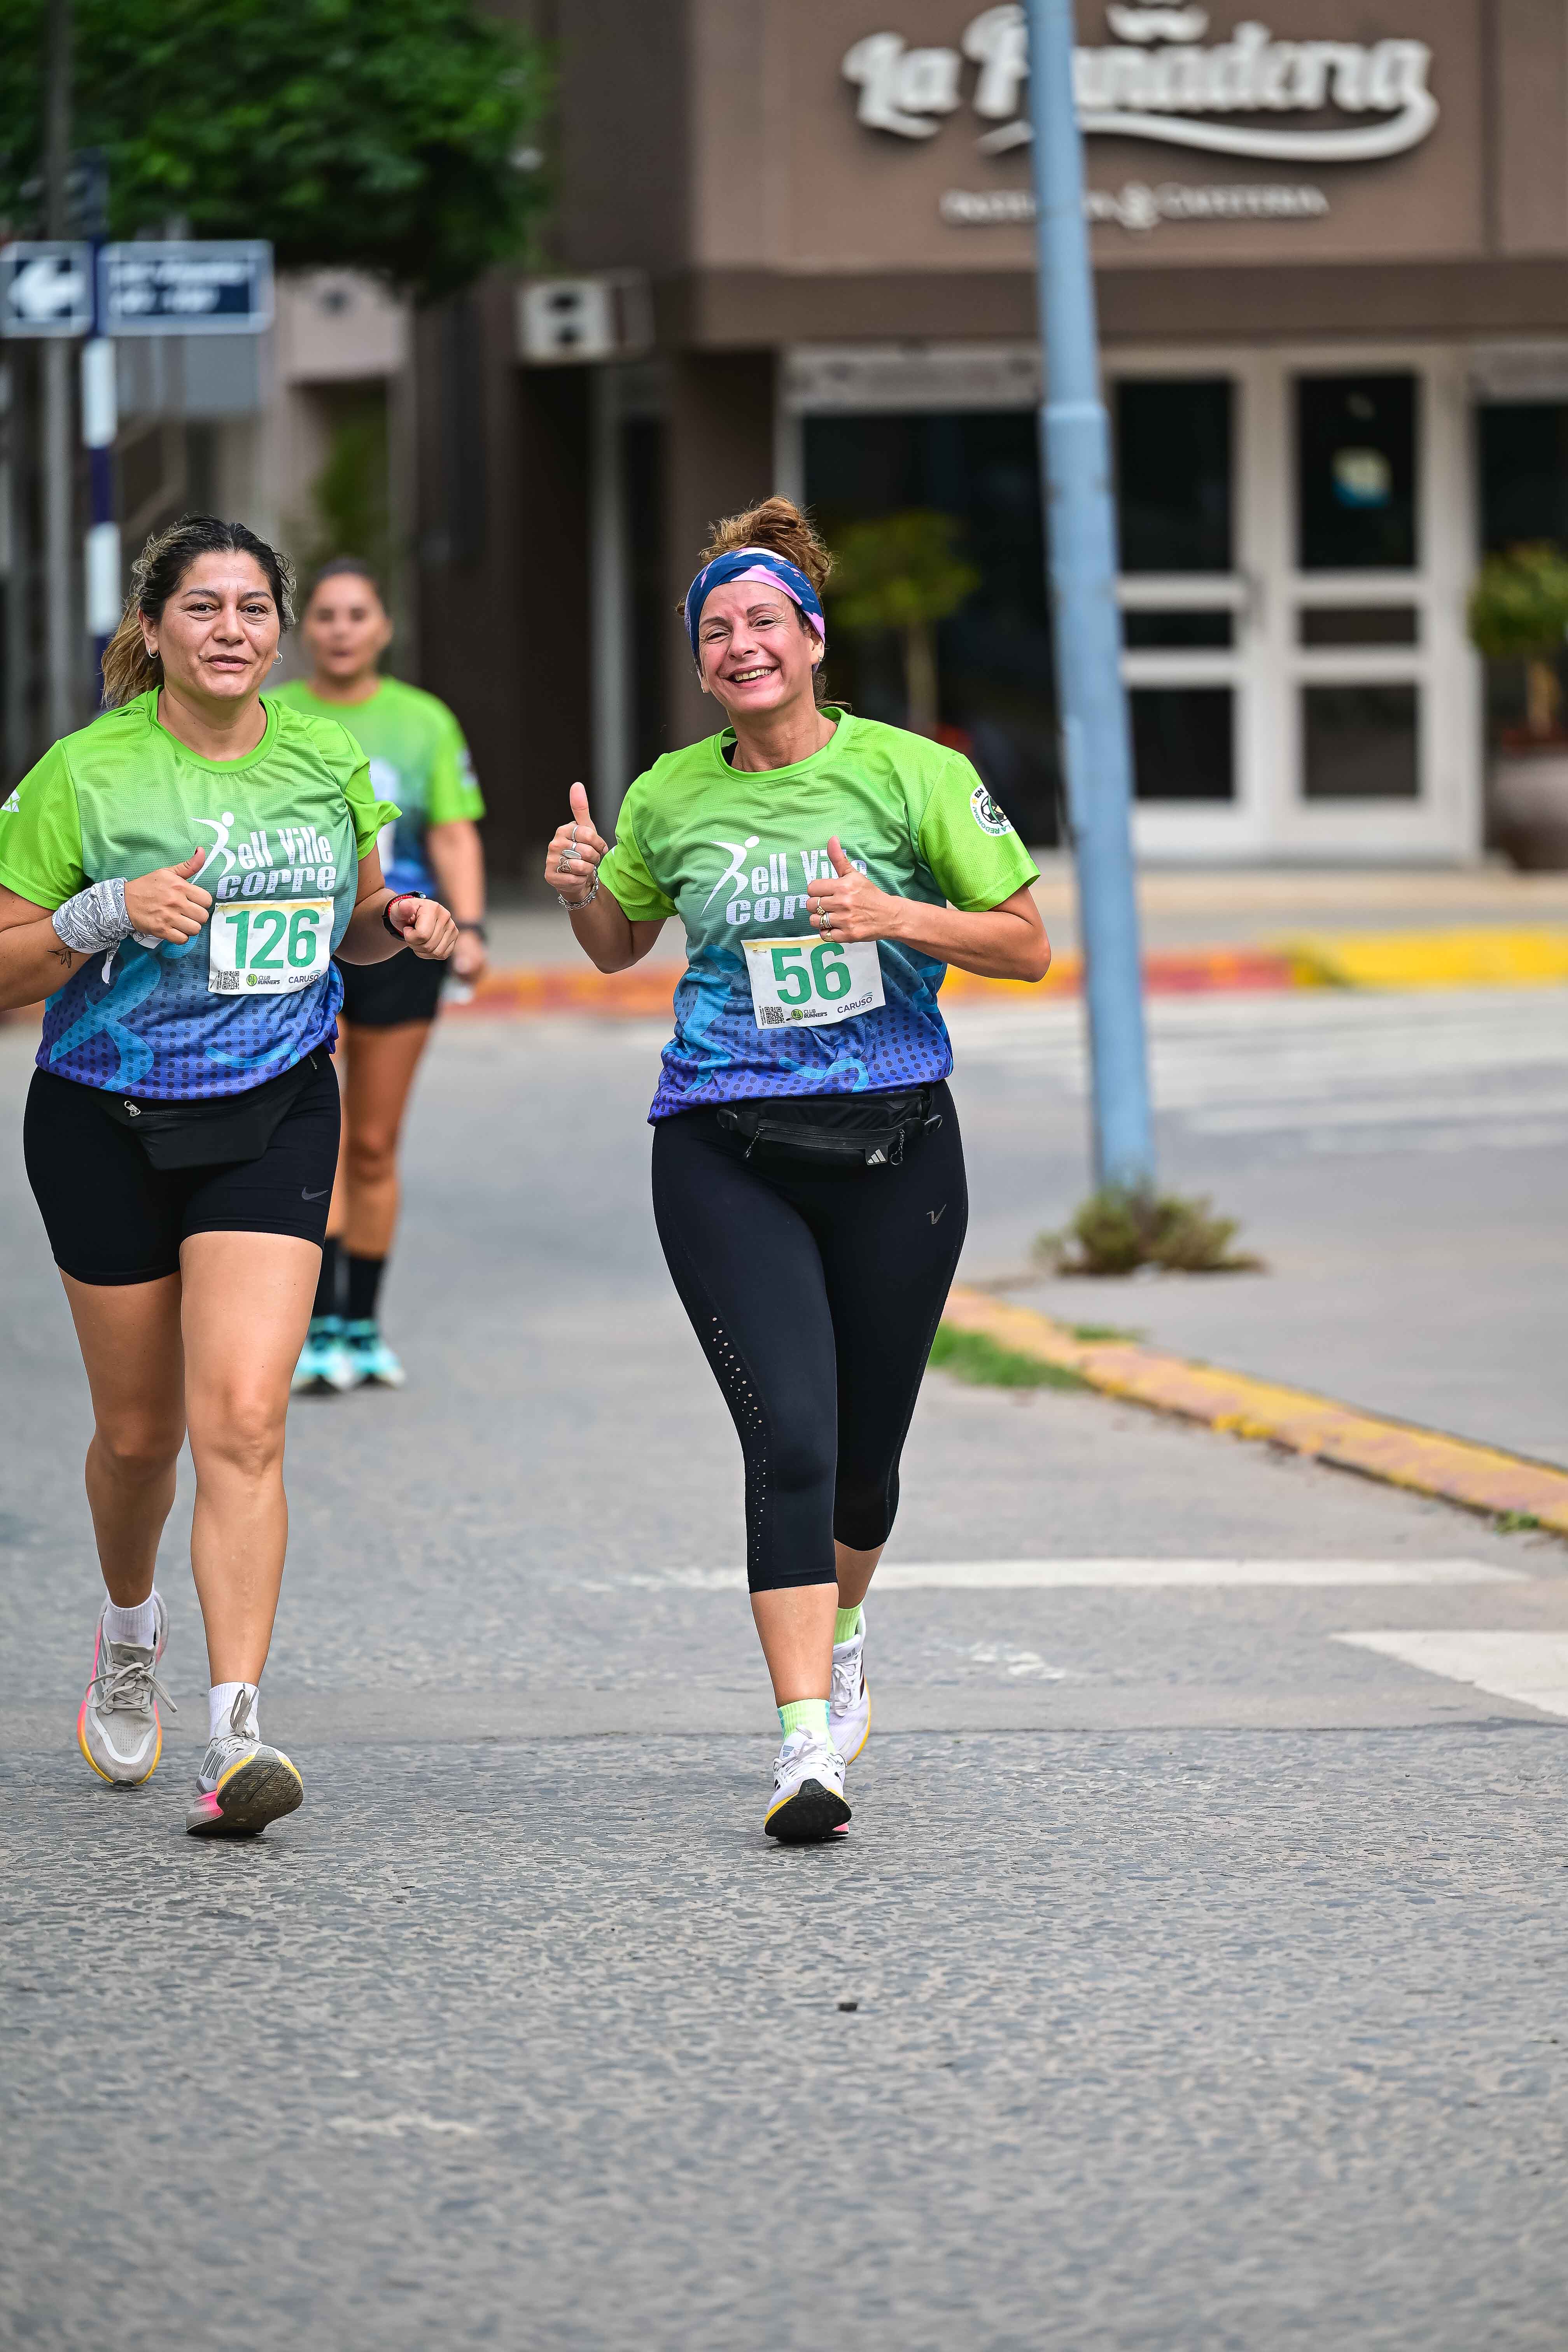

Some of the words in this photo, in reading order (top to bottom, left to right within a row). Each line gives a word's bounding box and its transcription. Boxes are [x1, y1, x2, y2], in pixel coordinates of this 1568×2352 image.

[277, 826, 333, 865] Ville
[216, 866, 336, 899] corre
[726, 894, 810, 925] cor
[226, 910, 319, 969] 126
[289, 975, 319, 983] CARUSO
[771, 943, 852, 1005] 56
[837, 997, 872, 1013] CARUSO
